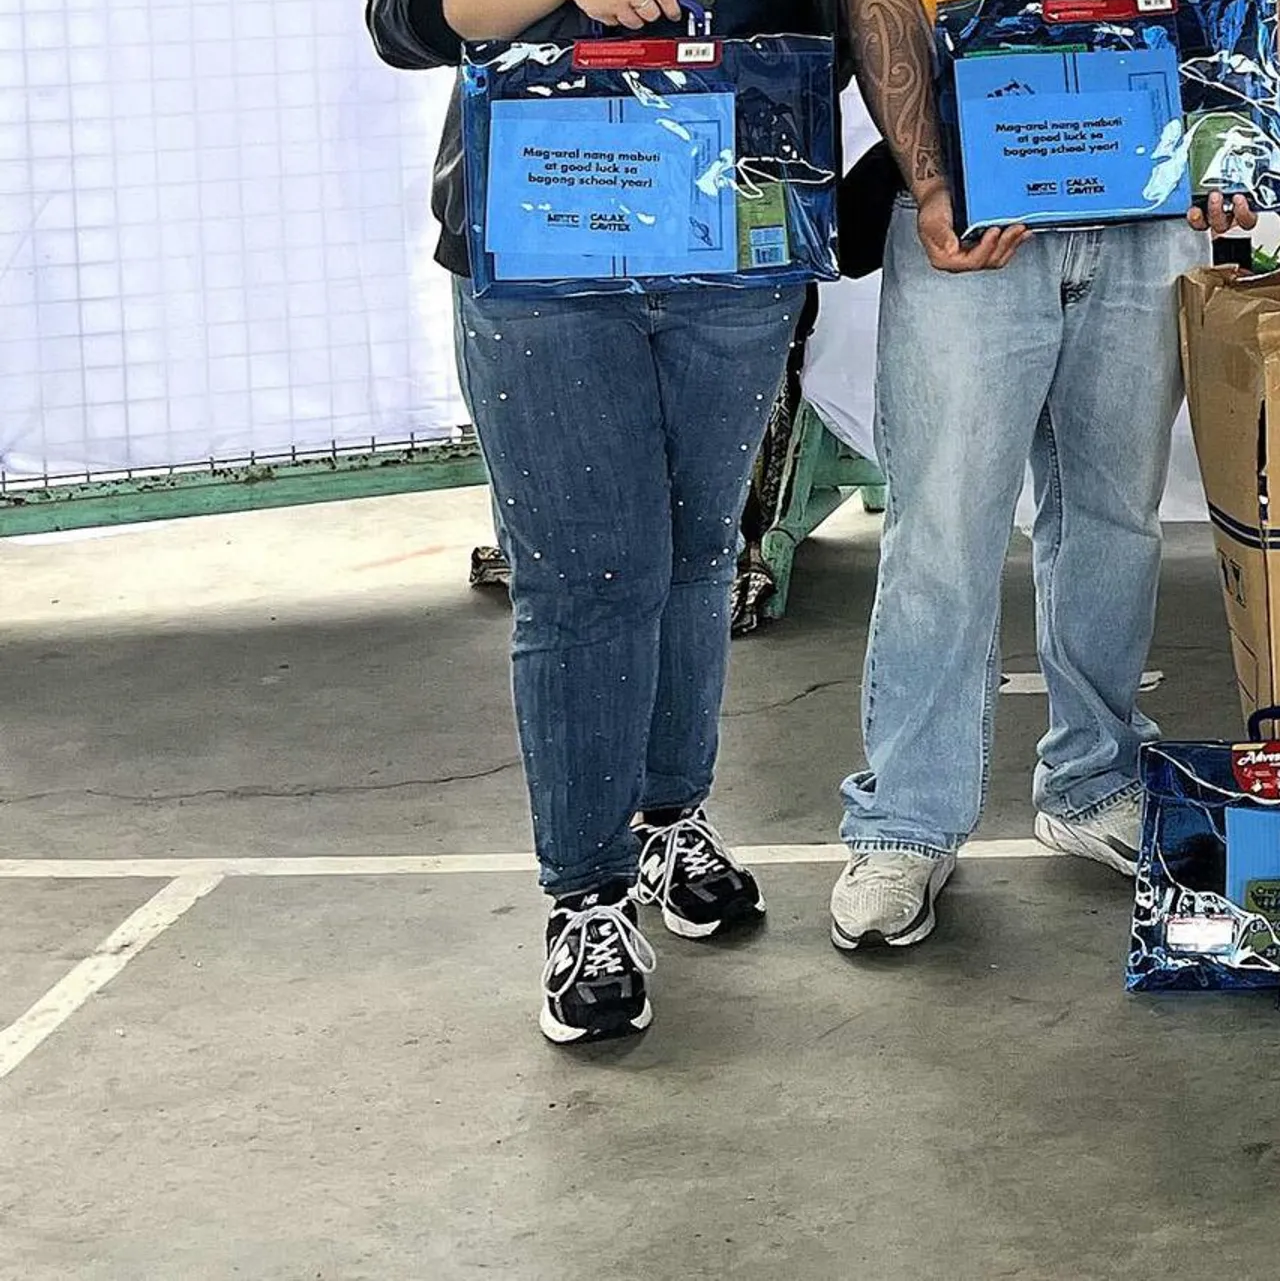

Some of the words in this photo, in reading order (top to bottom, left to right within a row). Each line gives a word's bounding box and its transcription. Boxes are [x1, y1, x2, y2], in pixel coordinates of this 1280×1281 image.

[1051, 121, 1080, 131] nang
[1032, 132, 1061, 145] good
[1063, 131, 1087, 140] luck
[583, 151, 615, 162] nang
[618, 151, 661, 162] mabuti
[1003, 146, 1048, 158] bagong
[1050, 142, 1086, 155] school
[544, 163, 557, 171] at
[560, 162, 592, 174] good
[595, 162, 619, 173] luck
[528, 172, 576, 186] bagong
[579, 175, 617, 186] school
